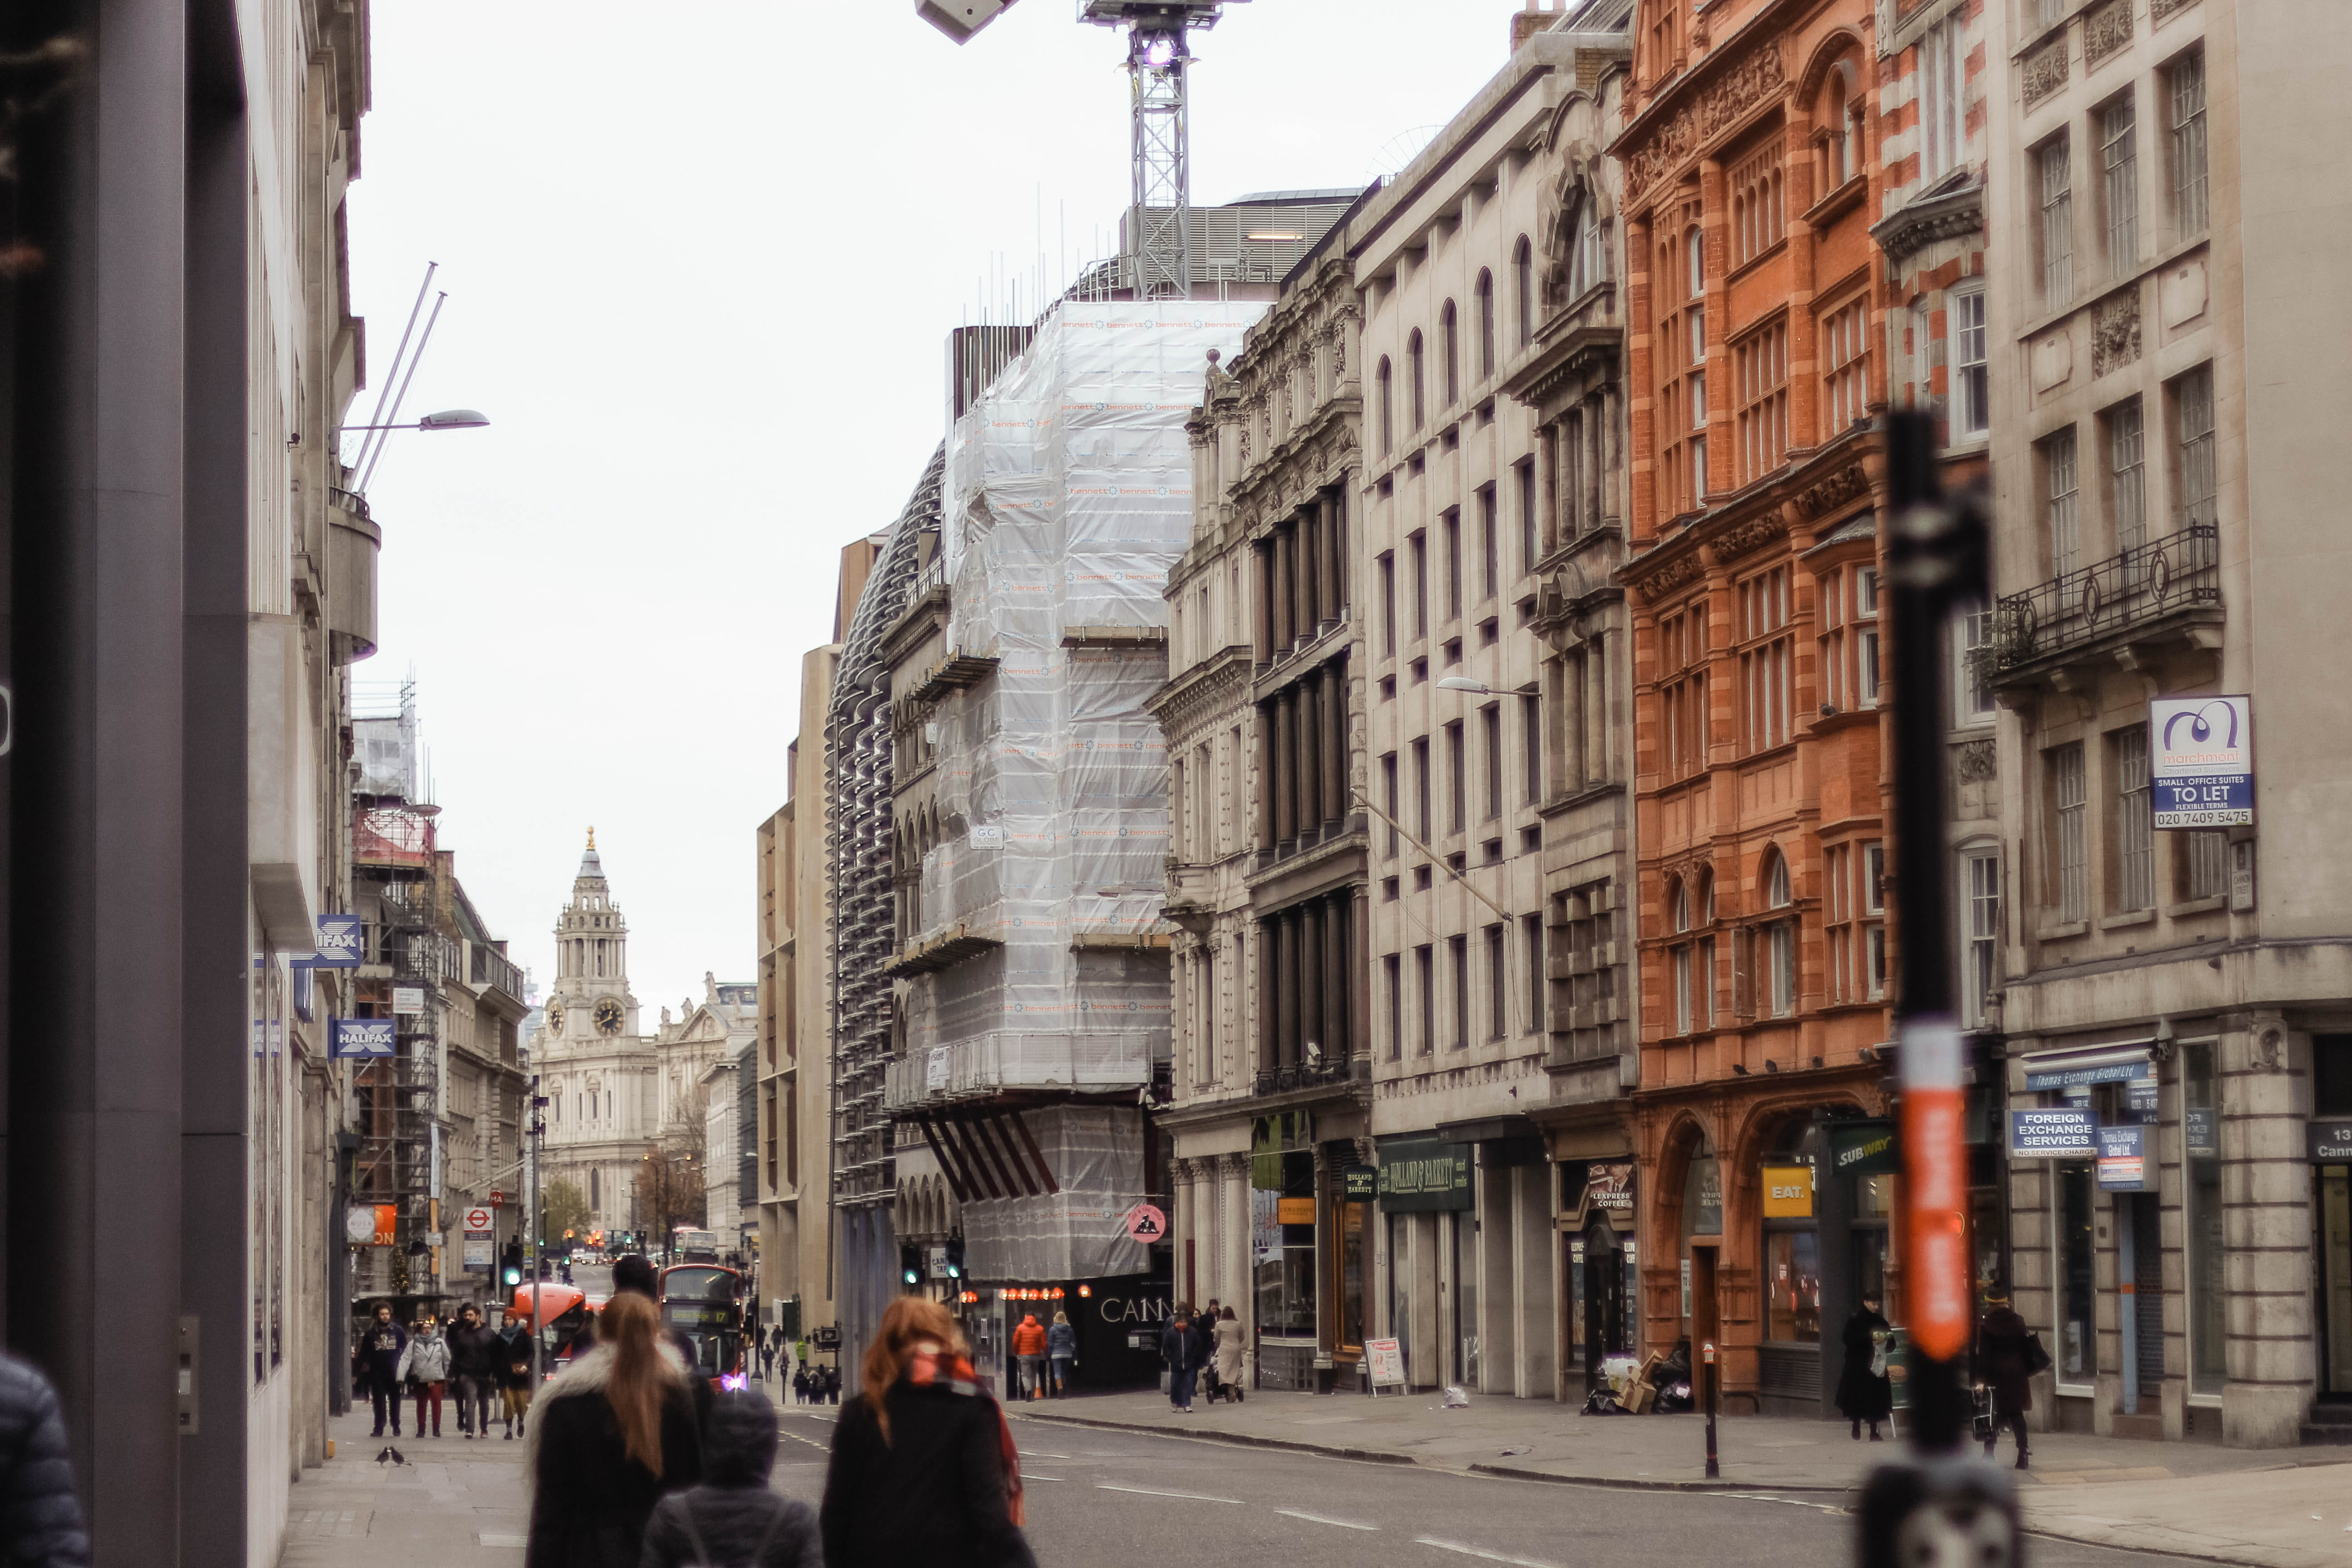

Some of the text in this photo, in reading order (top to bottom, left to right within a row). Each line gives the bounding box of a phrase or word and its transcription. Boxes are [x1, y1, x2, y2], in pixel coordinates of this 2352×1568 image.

[2164, 751, 2239, 764] marchmont
[2173, 786, 2230, 802] TO LET
[2158, 811, 2248, 824] 020 7409 5475
[978, 828, 995, 837] GC
[318, 935, 357, 947] IFAX
[339, 1034, 392, 1044] HALIFAX
[2037, 1065, 2134, 1087] Thomas Exchange Global Ltd
[2025, 1114, 2084, 1124] FOREIGN
[2019, 1125, 2092, 1135] EXCHANGE
[2024, 1136, 2089, 1146] SERVICES
[2102, 1130, 2138, 1145] Thomas Exchange
[1839, 1136, 1891, 1166] SUBWAY
[2108, 1144, 2122, 1156] Global
[1390, 1158, 1453, 1193] HOLLAND & BARRETT
[1772, 1186, 1804, 1199] EAT.
[716, 1312, 726, 1322] 17
